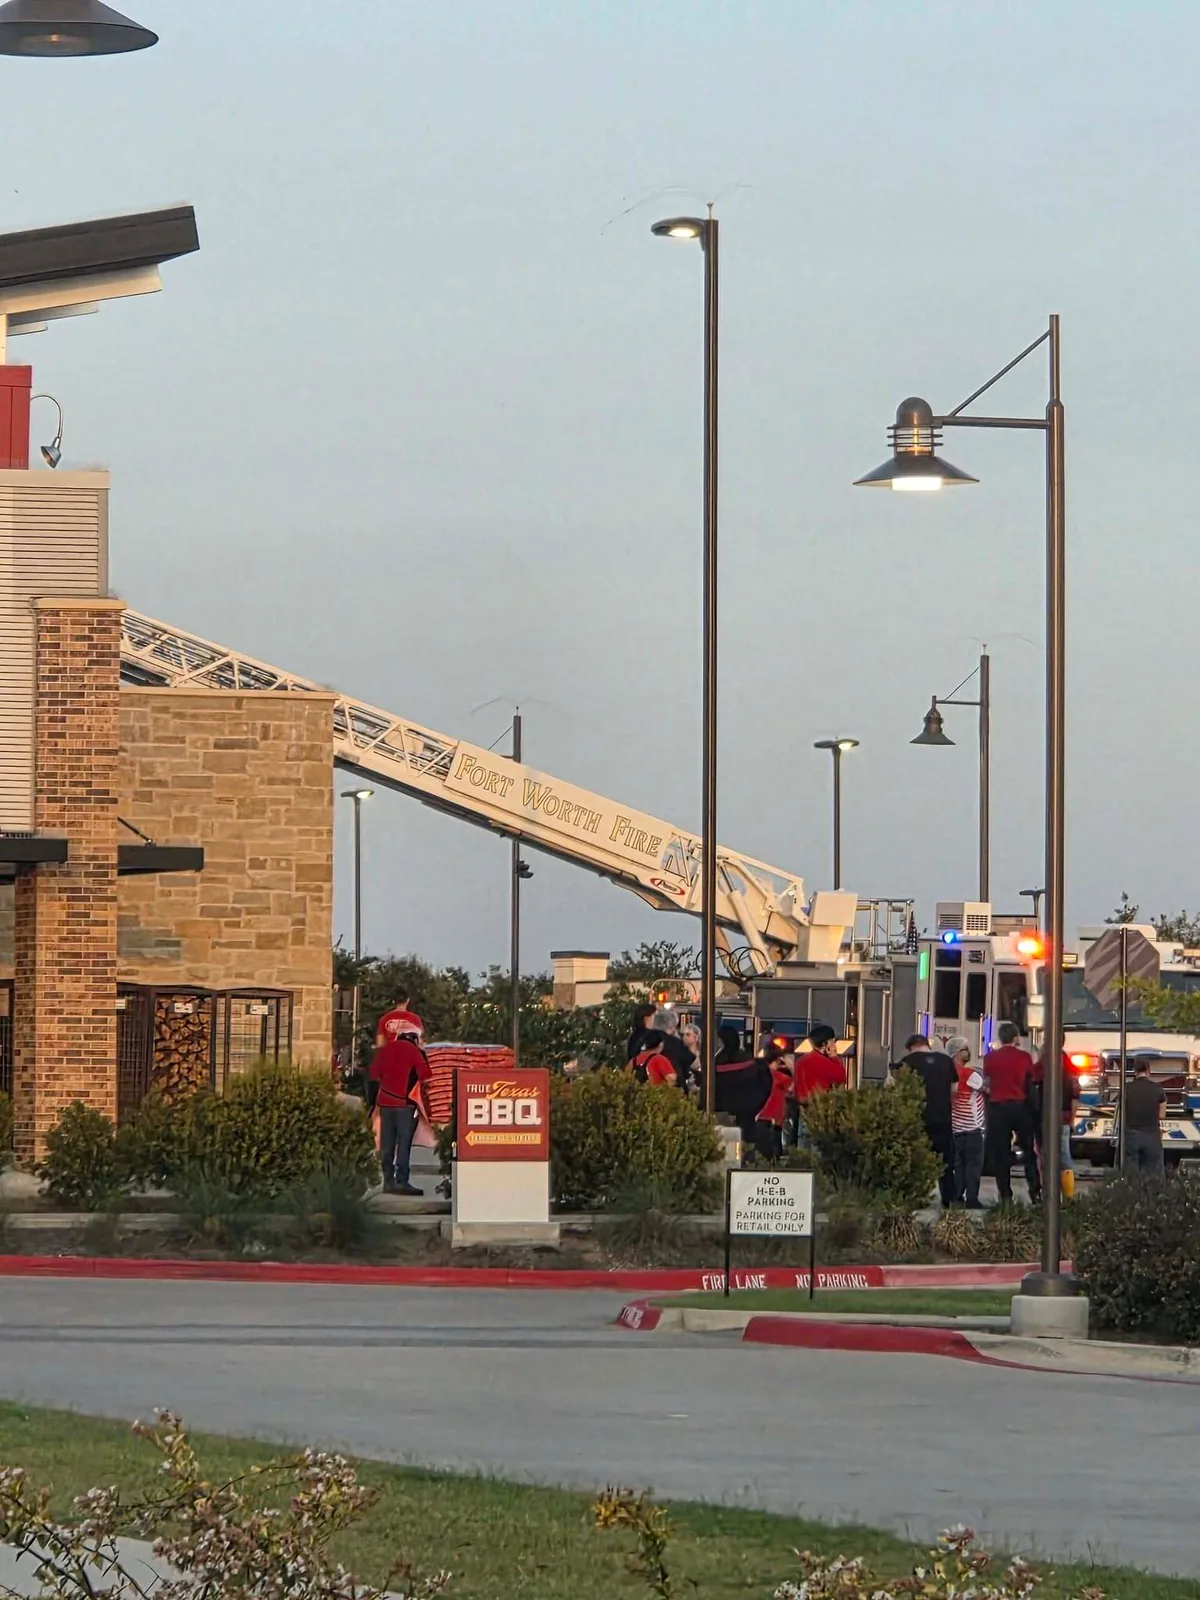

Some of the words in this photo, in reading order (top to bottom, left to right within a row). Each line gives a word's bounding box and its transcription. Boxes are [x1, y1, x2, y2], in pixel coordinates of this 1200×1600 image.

[454, 753, 515, 798] FORT
[522, 778, 603, 833] WORTH
[608, 815, 662, 857] FIRE
[466, 1084, 490, 1093] TRUE
[486, 1081, 540, 1100] Texas
[467, 1098, 541, 1125] BBQ
[763, 1177, 780, 1185] NO
[756, 1187, 786, 1196] H-E-B
[747, 1197, 795, 1207] PARKING
[736, 1211, 782, 1221] PARKING
[784, 1212, 805, 1221] FOR
[737, 1222, 772, 1231] RETAIL
[775, 1223, 804, 1232] ONLY
[735, 1274, 767, 1289] LANE
[795, 1274, 811, 1288] NO
[818, 1273, 868, 1288] PARKING
